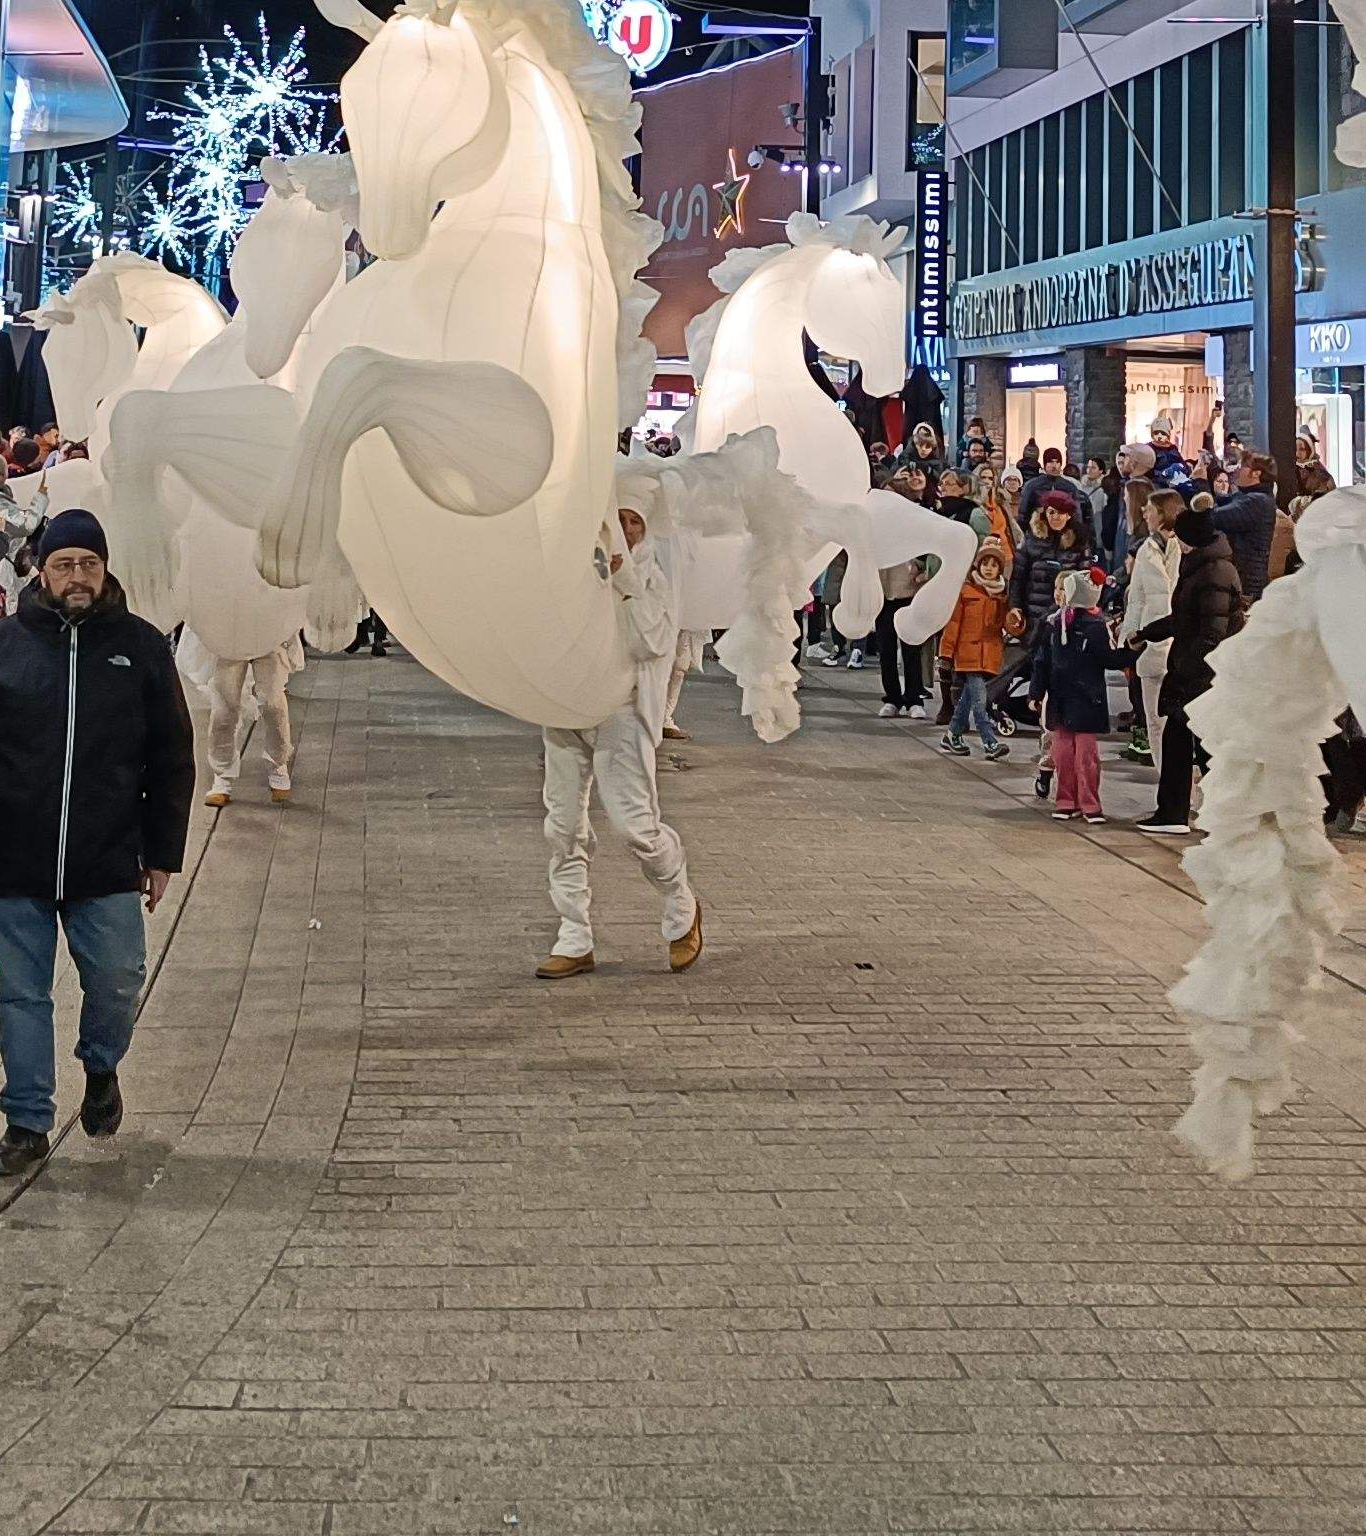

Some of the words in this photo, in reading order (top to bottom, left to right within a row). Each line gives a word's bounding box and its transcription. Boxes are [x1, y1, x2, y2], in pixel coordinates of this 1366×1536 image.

[920, 173, 941, 335] intimissimi
[952, 284, 1017, 342] COMPANYIA
[1022, 264, 1110, 331] ANDORRANA
[1118, 221, 1299, 316] D'ASSEGURAN
[1309, 322, 1351, 353] KIKO
[1129, 382, 1218, 395] intimissimi
